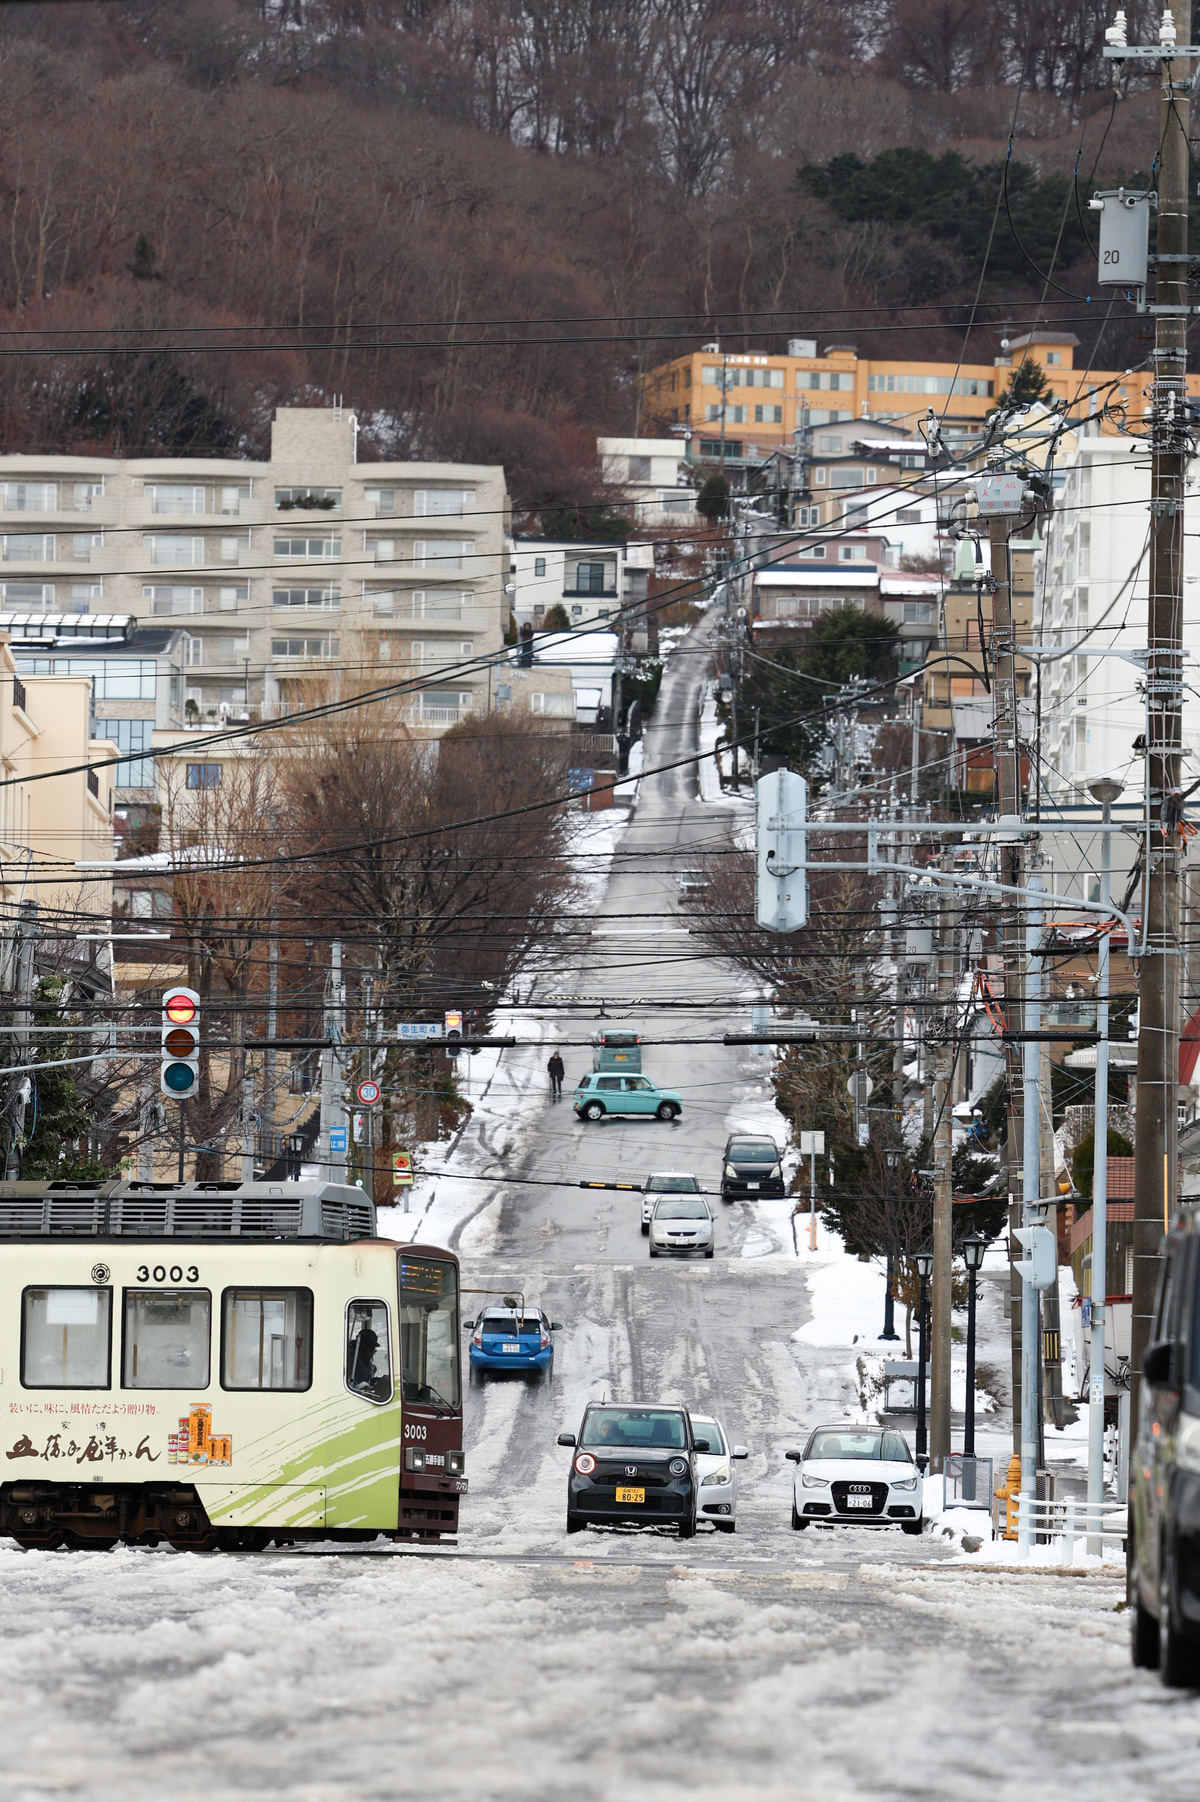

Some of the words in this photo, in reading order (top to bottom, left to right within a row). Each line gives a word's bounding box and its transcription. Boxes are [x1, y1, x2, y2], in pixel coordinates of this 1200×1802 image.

[1103, 250, 1120, 265] 20
[362, 1087, 376, 1098] 30
[136, 1265, 200, 1283] 3003
[404, 1424, 427, 1440] 3003
